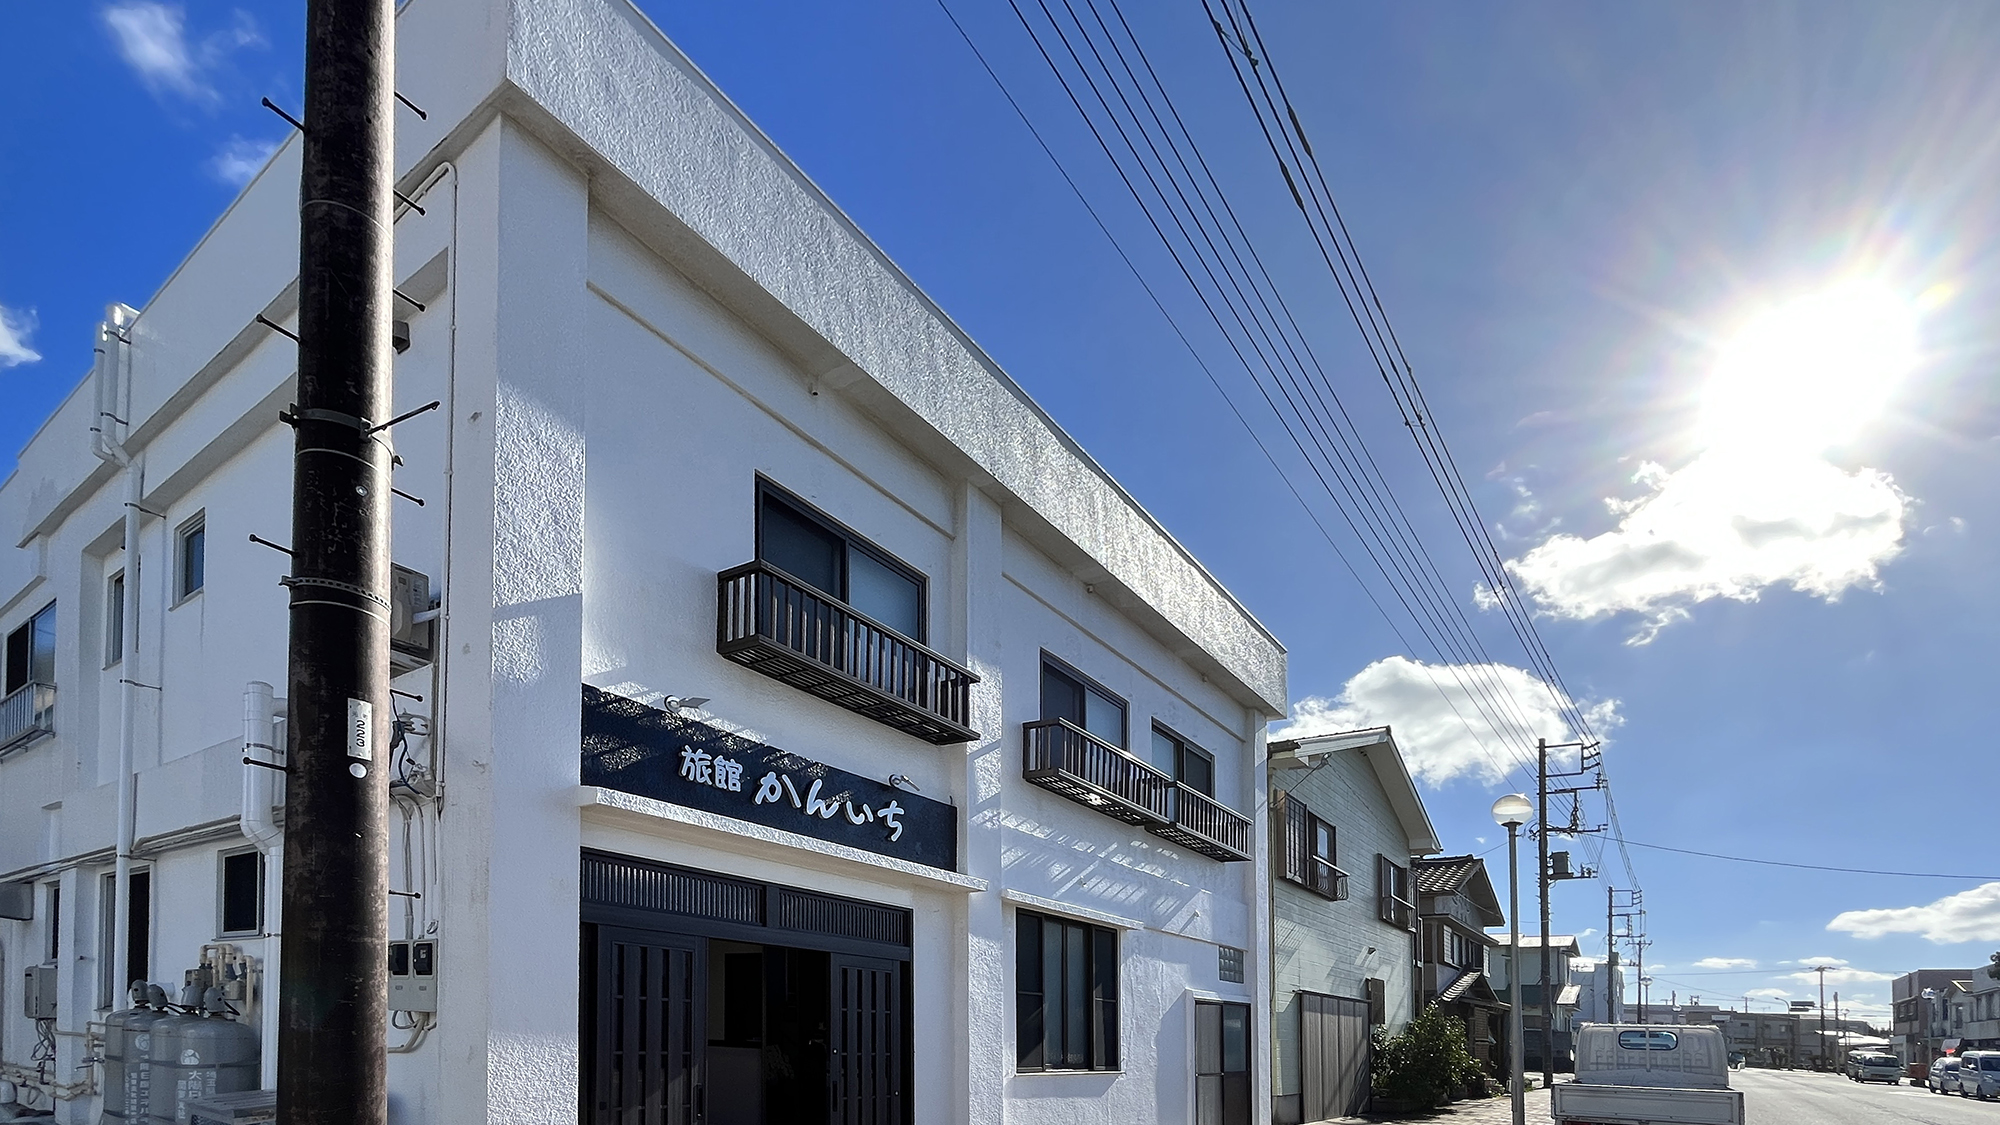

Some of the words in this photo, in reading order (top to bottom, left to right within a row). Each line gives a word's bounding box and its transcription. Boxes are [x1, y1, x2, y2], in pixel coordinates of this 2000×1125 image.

[356, 719, 365, 748] 223
[679, 744, 743, 793] 旅館
[752, 770, 905, 842] かんいち
